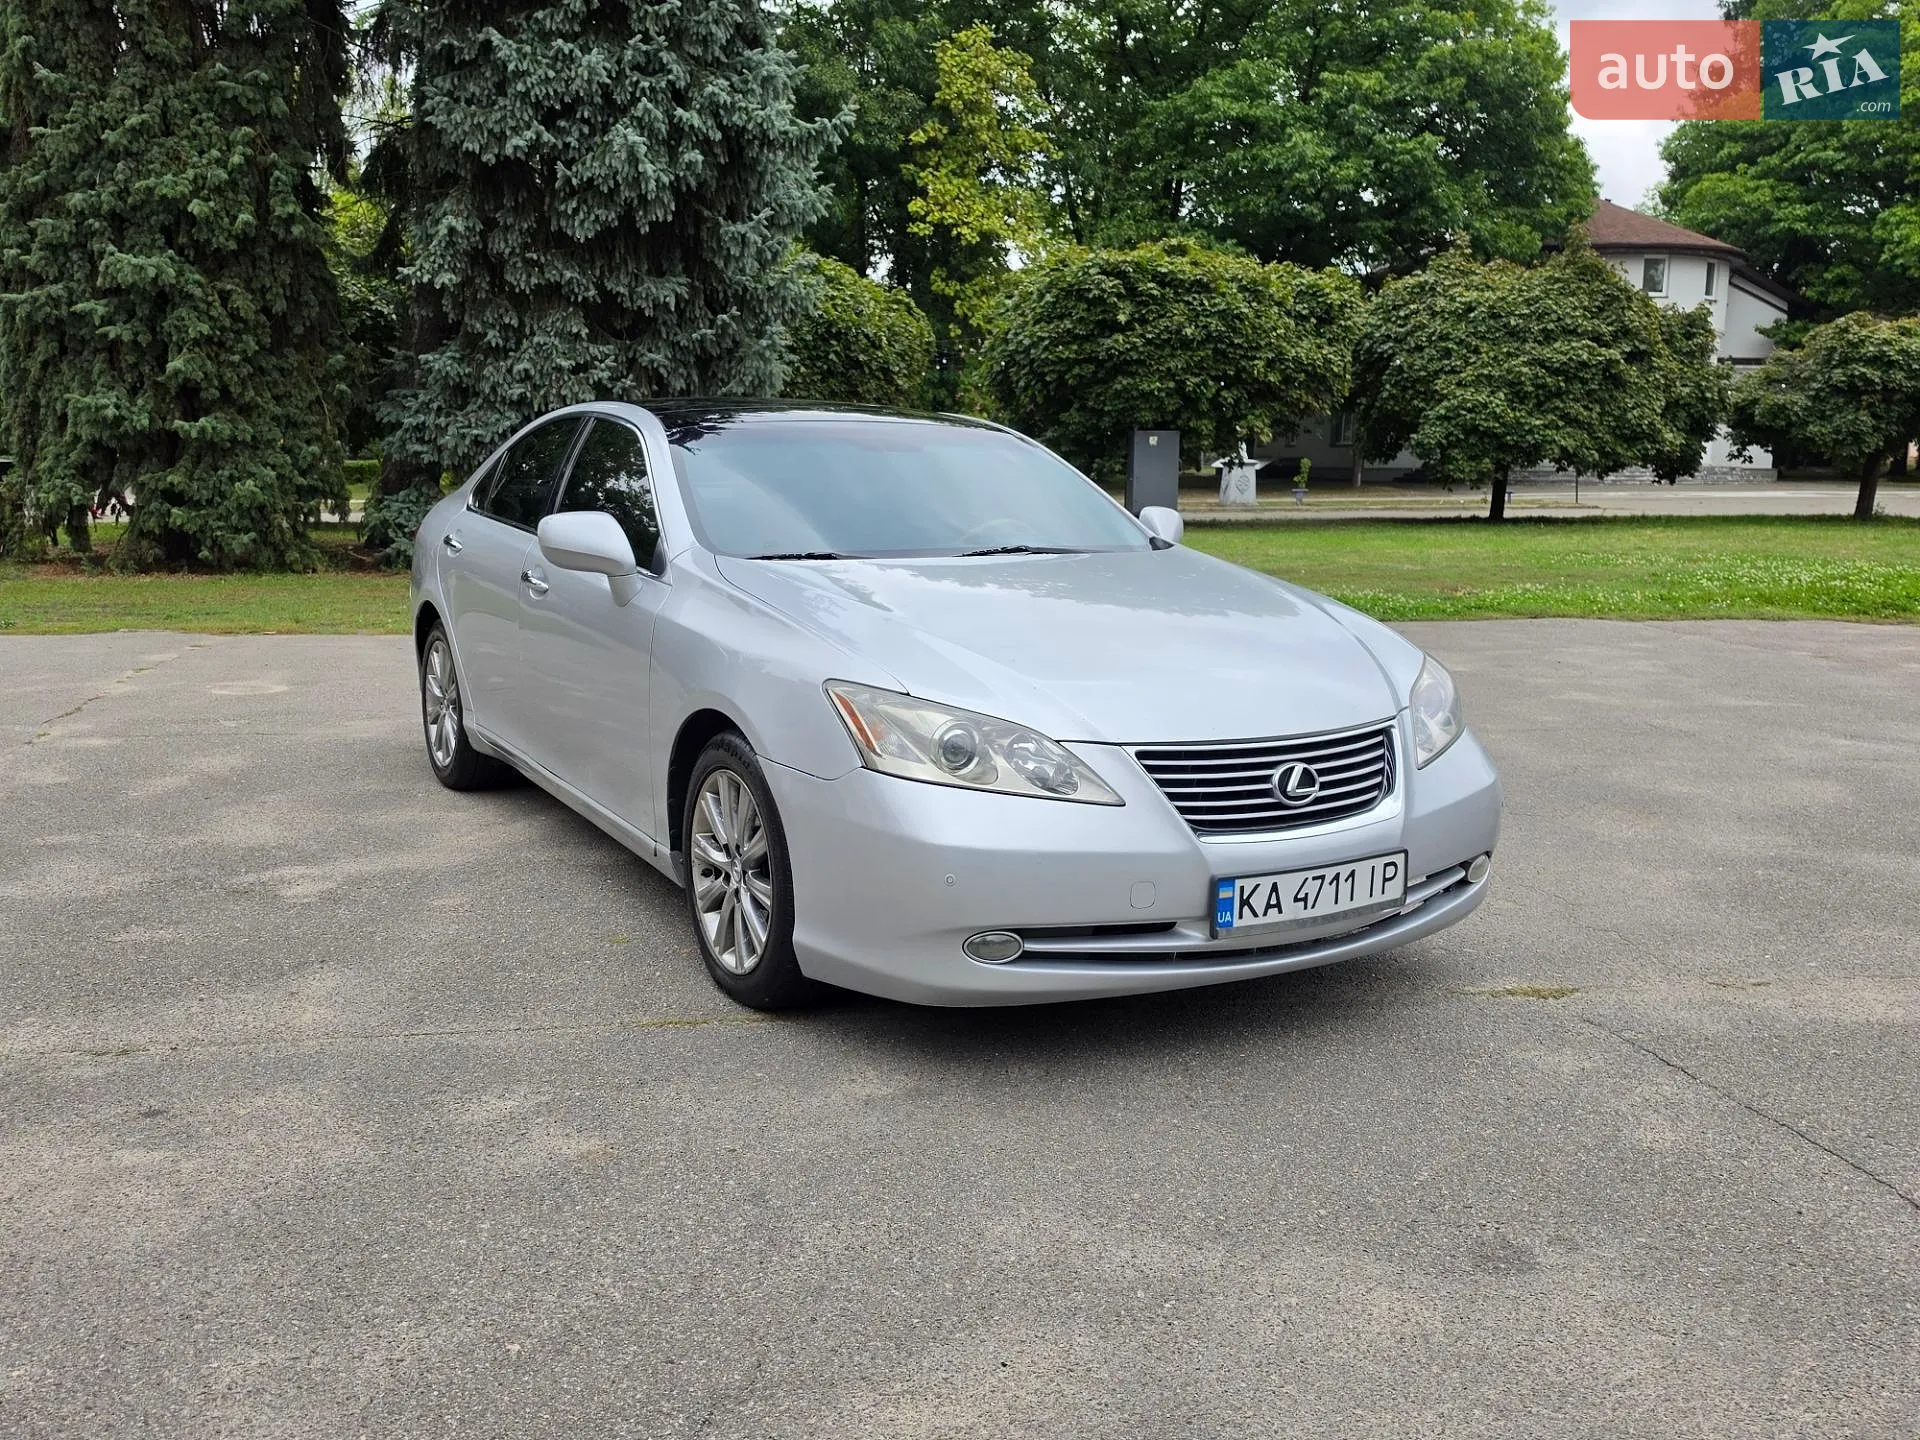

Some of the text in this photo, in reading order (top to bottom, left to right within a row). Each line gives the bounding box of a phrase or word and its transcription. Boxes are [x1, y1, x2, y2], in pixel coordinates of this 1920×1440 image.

[1238, 881, 1283, 920] KA
[1293, 868, 1356, 910] 4711
[1369, 861, 1399, 898] IP
[1217, 911, 1232, 923] UA
